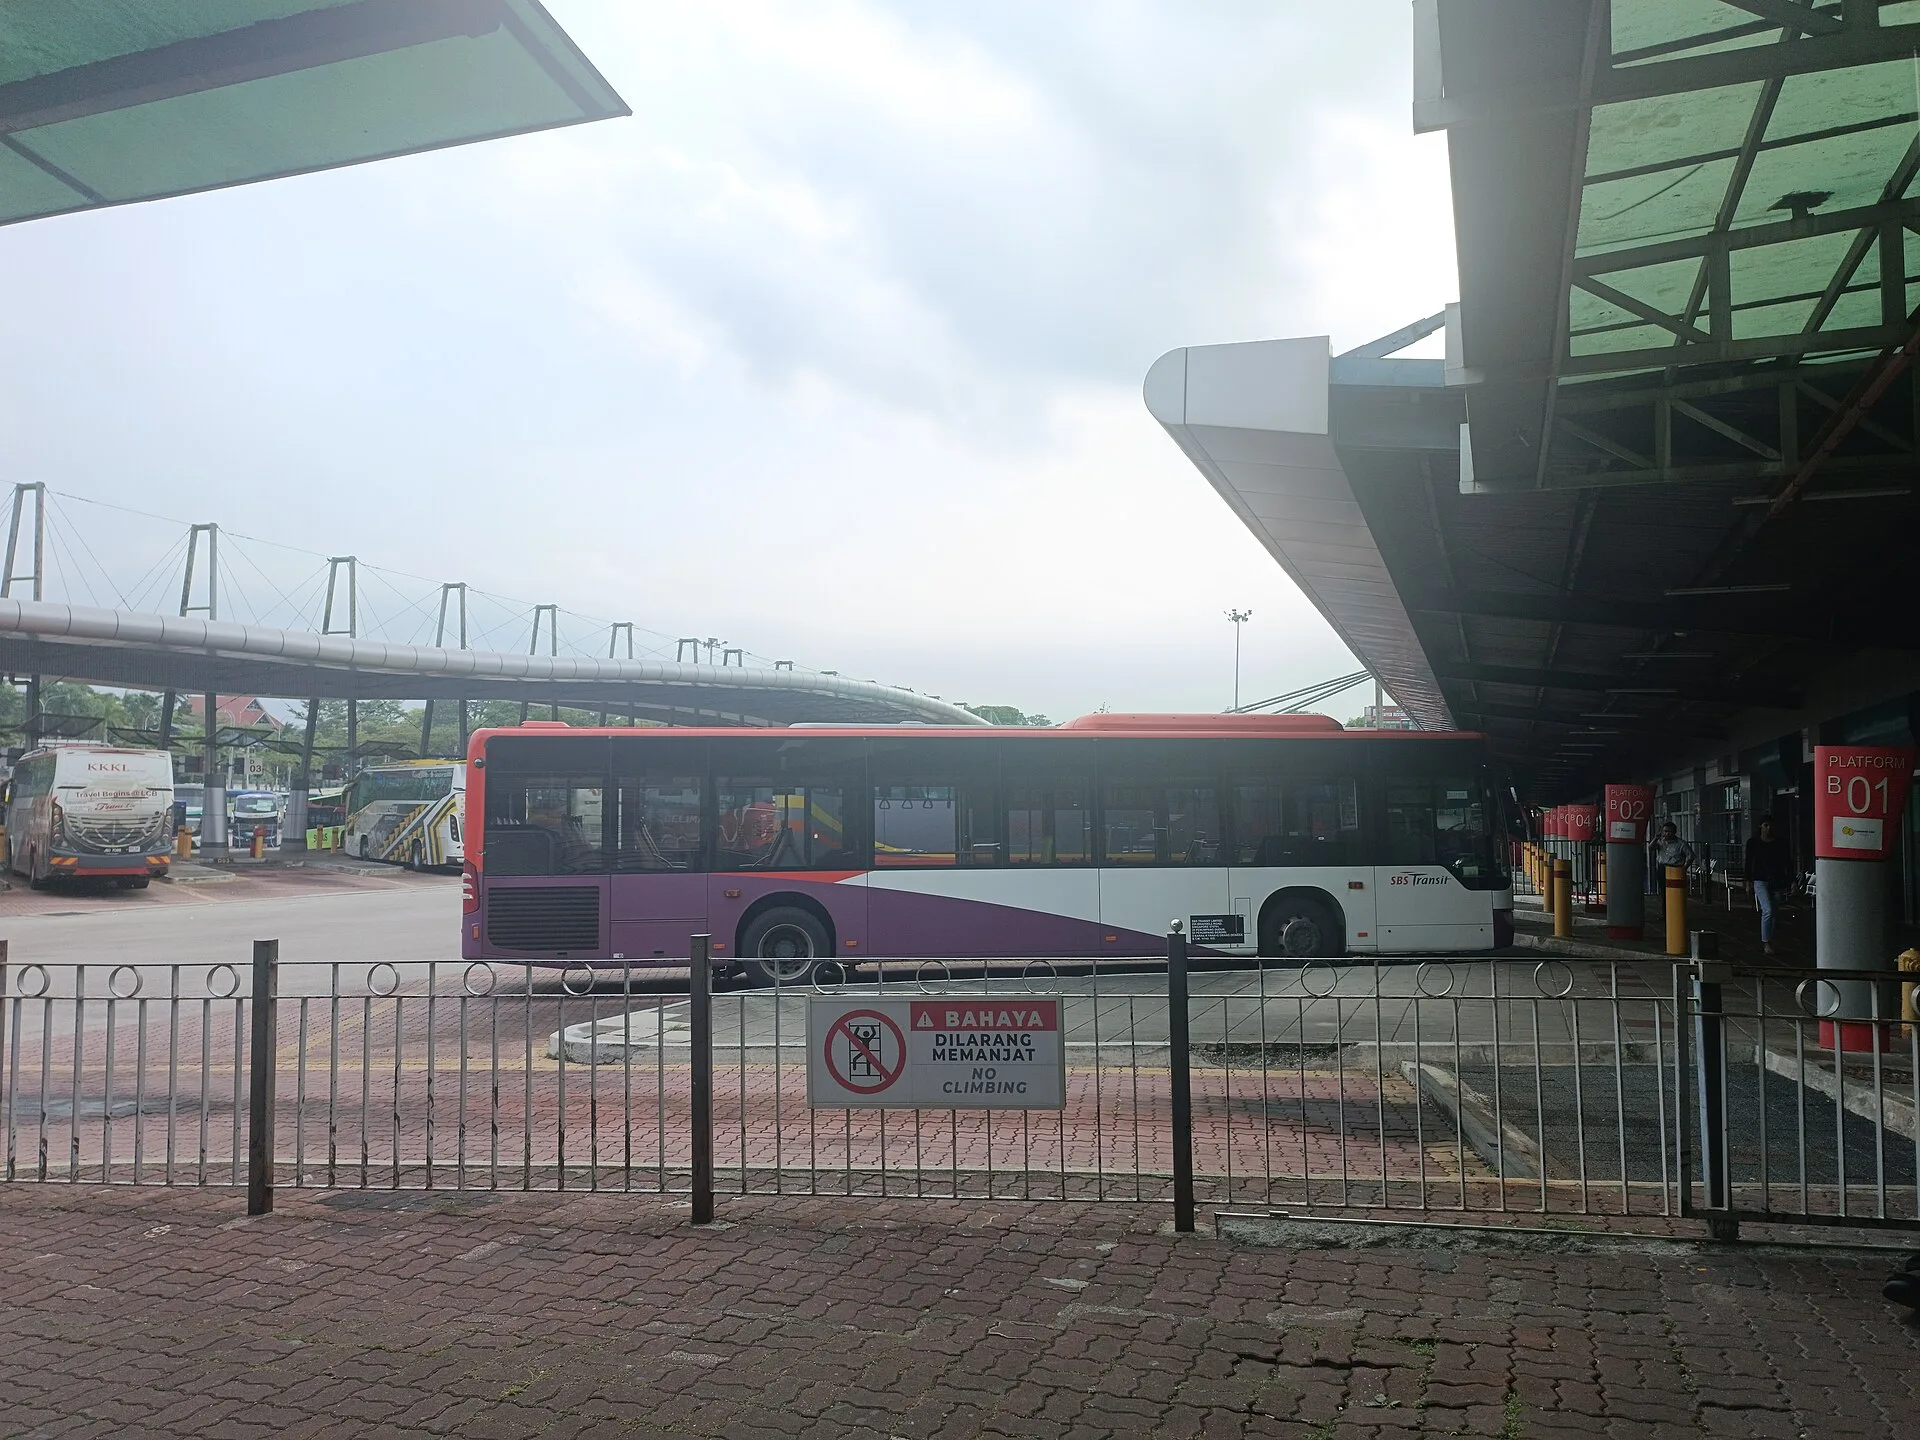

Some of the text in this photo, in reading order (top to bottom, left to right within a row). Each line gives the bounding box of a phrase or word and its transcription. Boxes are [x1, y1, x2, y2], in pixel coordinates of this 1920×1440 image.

[249, 765, 262, 773] 03
[1829, 755, 1905, 769] PLATFORM
[1827, 775, 1889, 814] B 01
[1610, 799, 1645, 820] B 02
[1390, 871, 1452, 886] SBS Transit
[945, 1010, 1044, 1027] BAHAYA
[935, 1033, 1032, 1047] DILARANG
[932, 1048, 1036, 1062] MEMANJAT
[972, 1068, 996, 1080] NO
[942, 1081, 1028, 1094] CLIMBING
